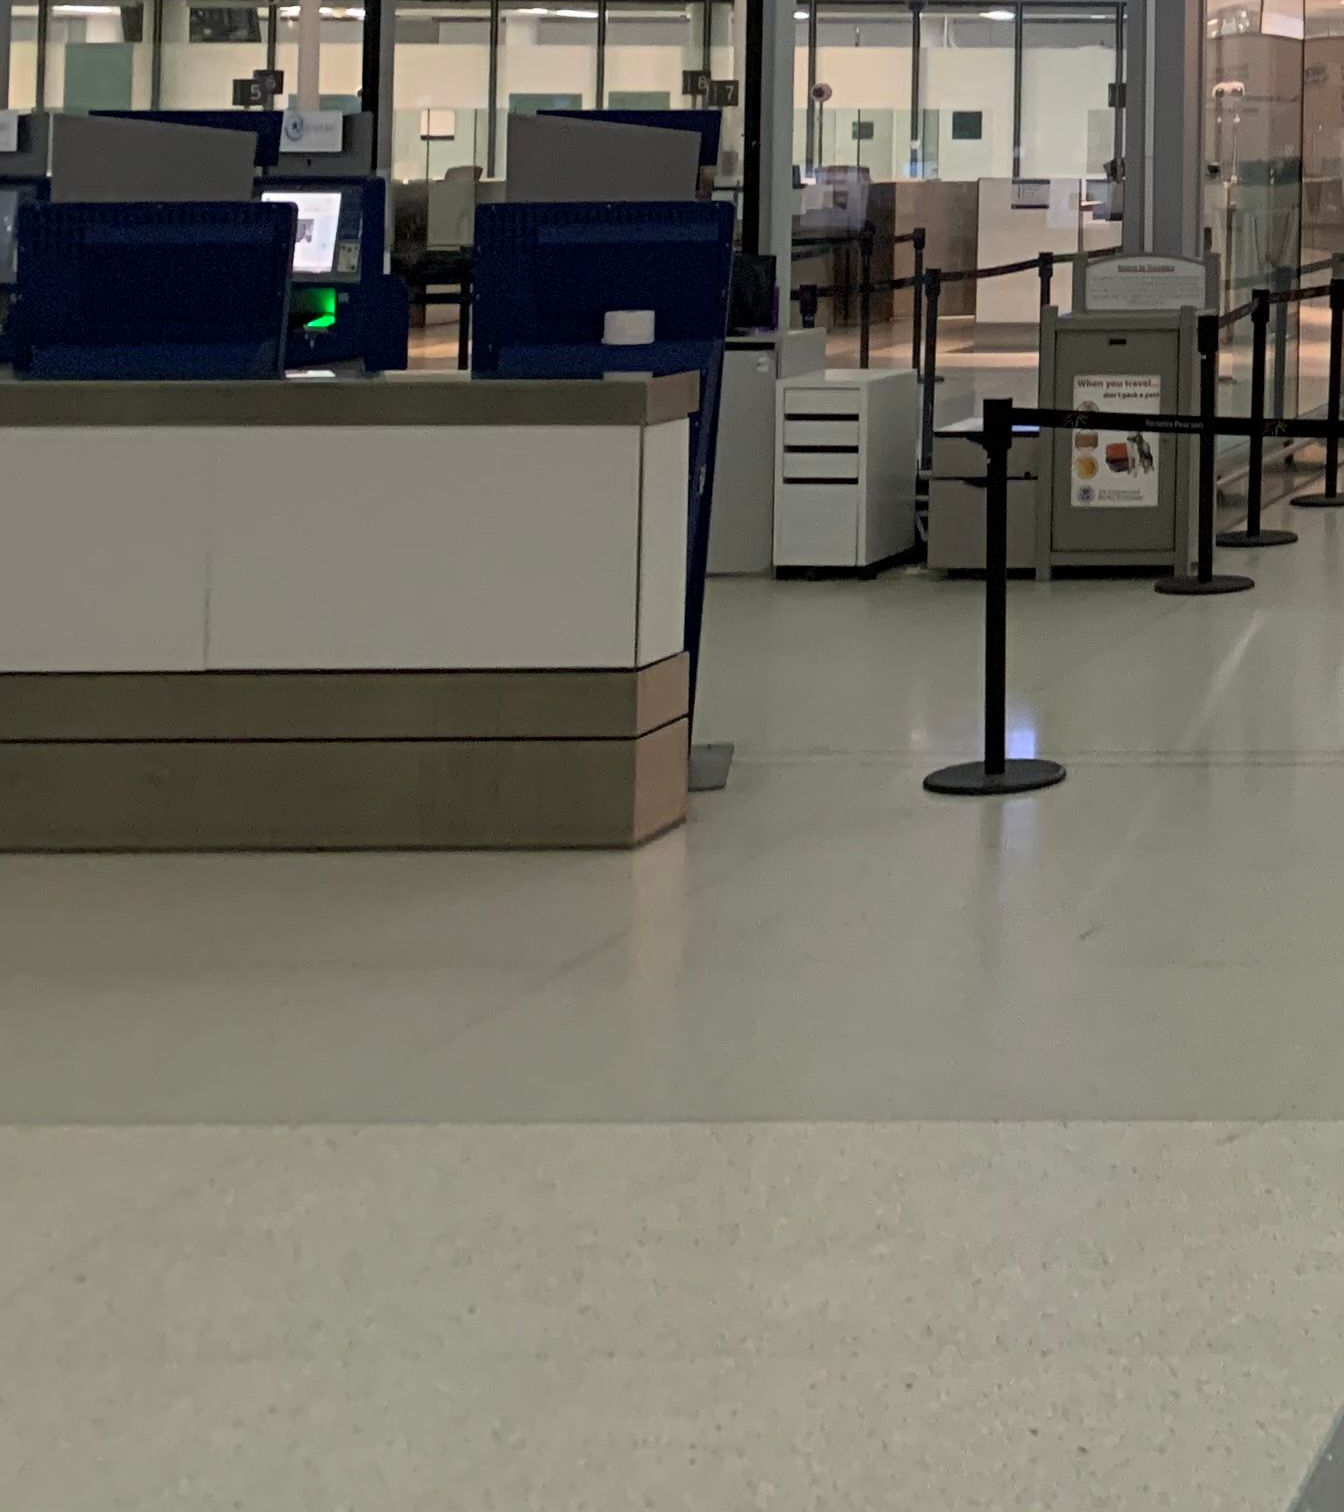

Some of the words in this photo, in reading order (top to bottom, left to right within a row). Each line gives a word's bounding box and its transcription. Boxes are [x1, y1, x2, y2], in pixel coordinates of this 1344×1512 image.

[250, 84, 262, 100] 5
[1077, 379, 1104, 388] When
[1105, 379, 1123, 390] you
[1103, 391, 1122, 399] don't
[1122, 392, 1138, 400] pack
